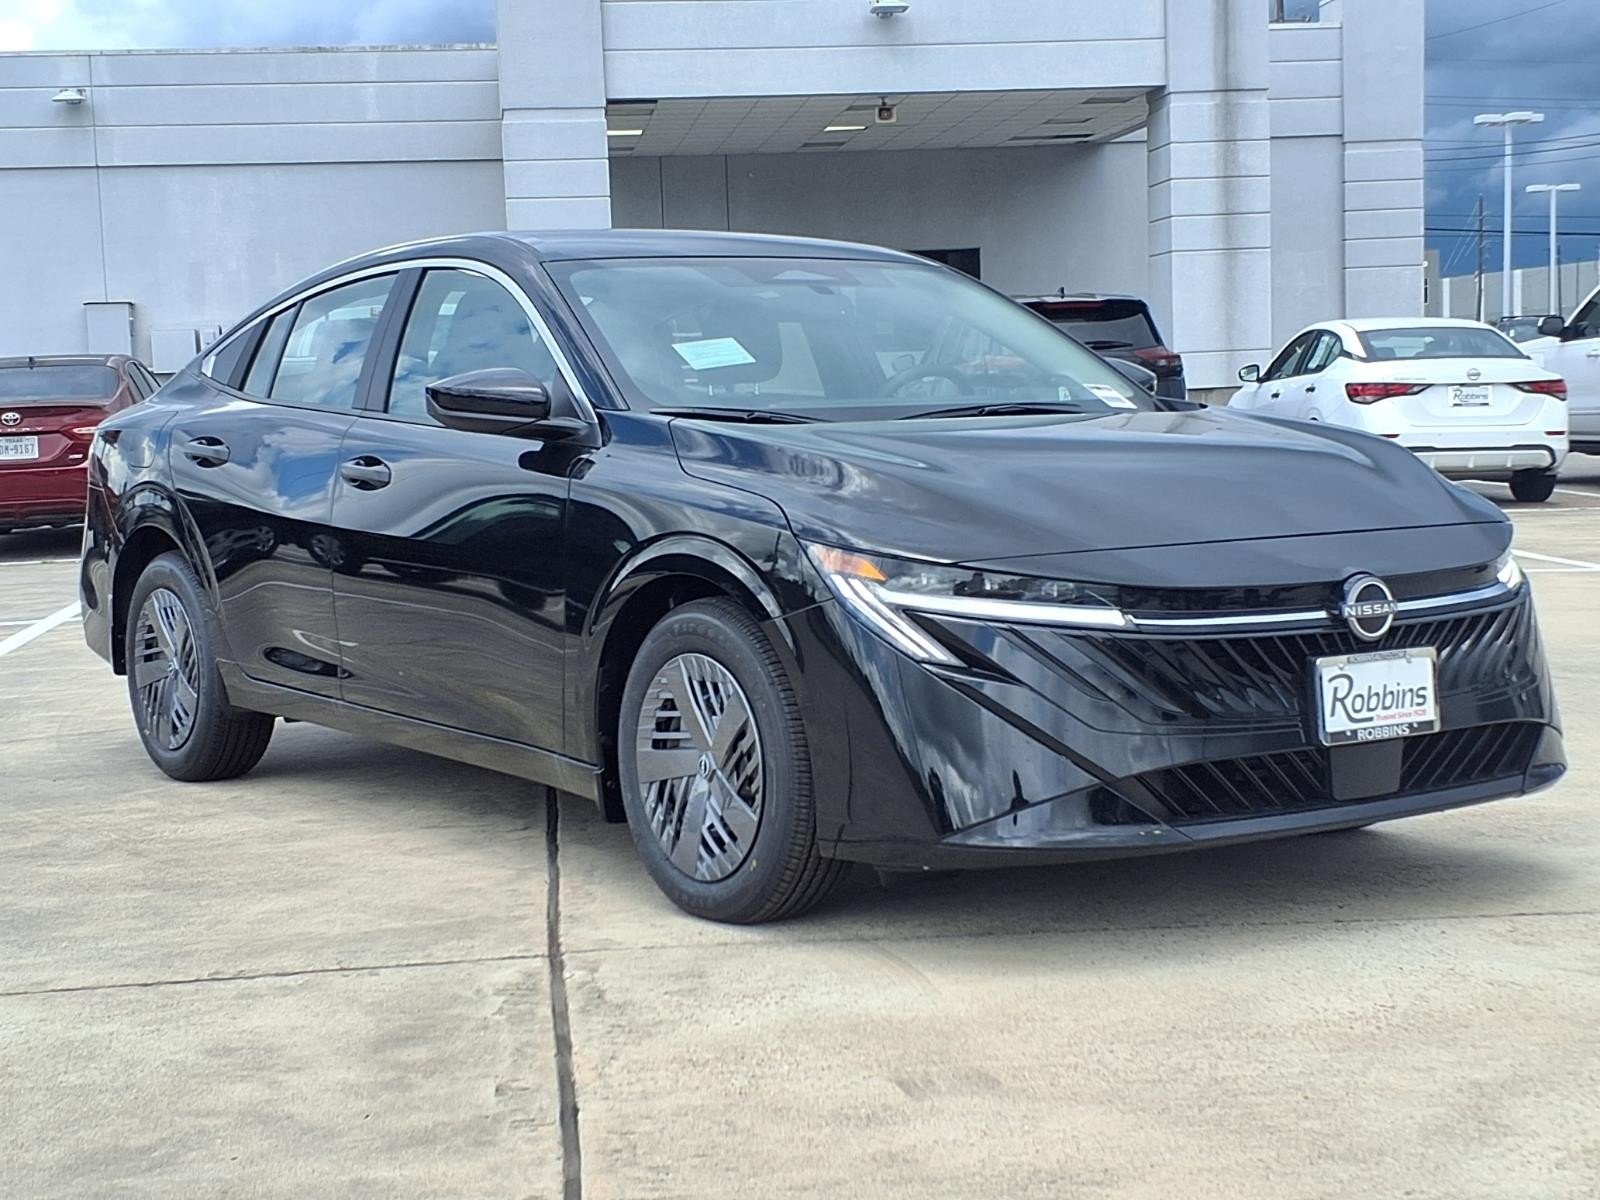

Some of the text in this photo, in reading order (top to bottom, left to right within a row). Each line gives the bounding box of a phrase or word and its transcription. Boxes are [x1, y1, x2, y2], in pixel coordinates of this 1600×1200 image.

[1344, 602, 1399, 617] NISSAN
[1328, 673, 1428, 724] Robbins
[1357, 723, 1411, 741] ROBBINS
